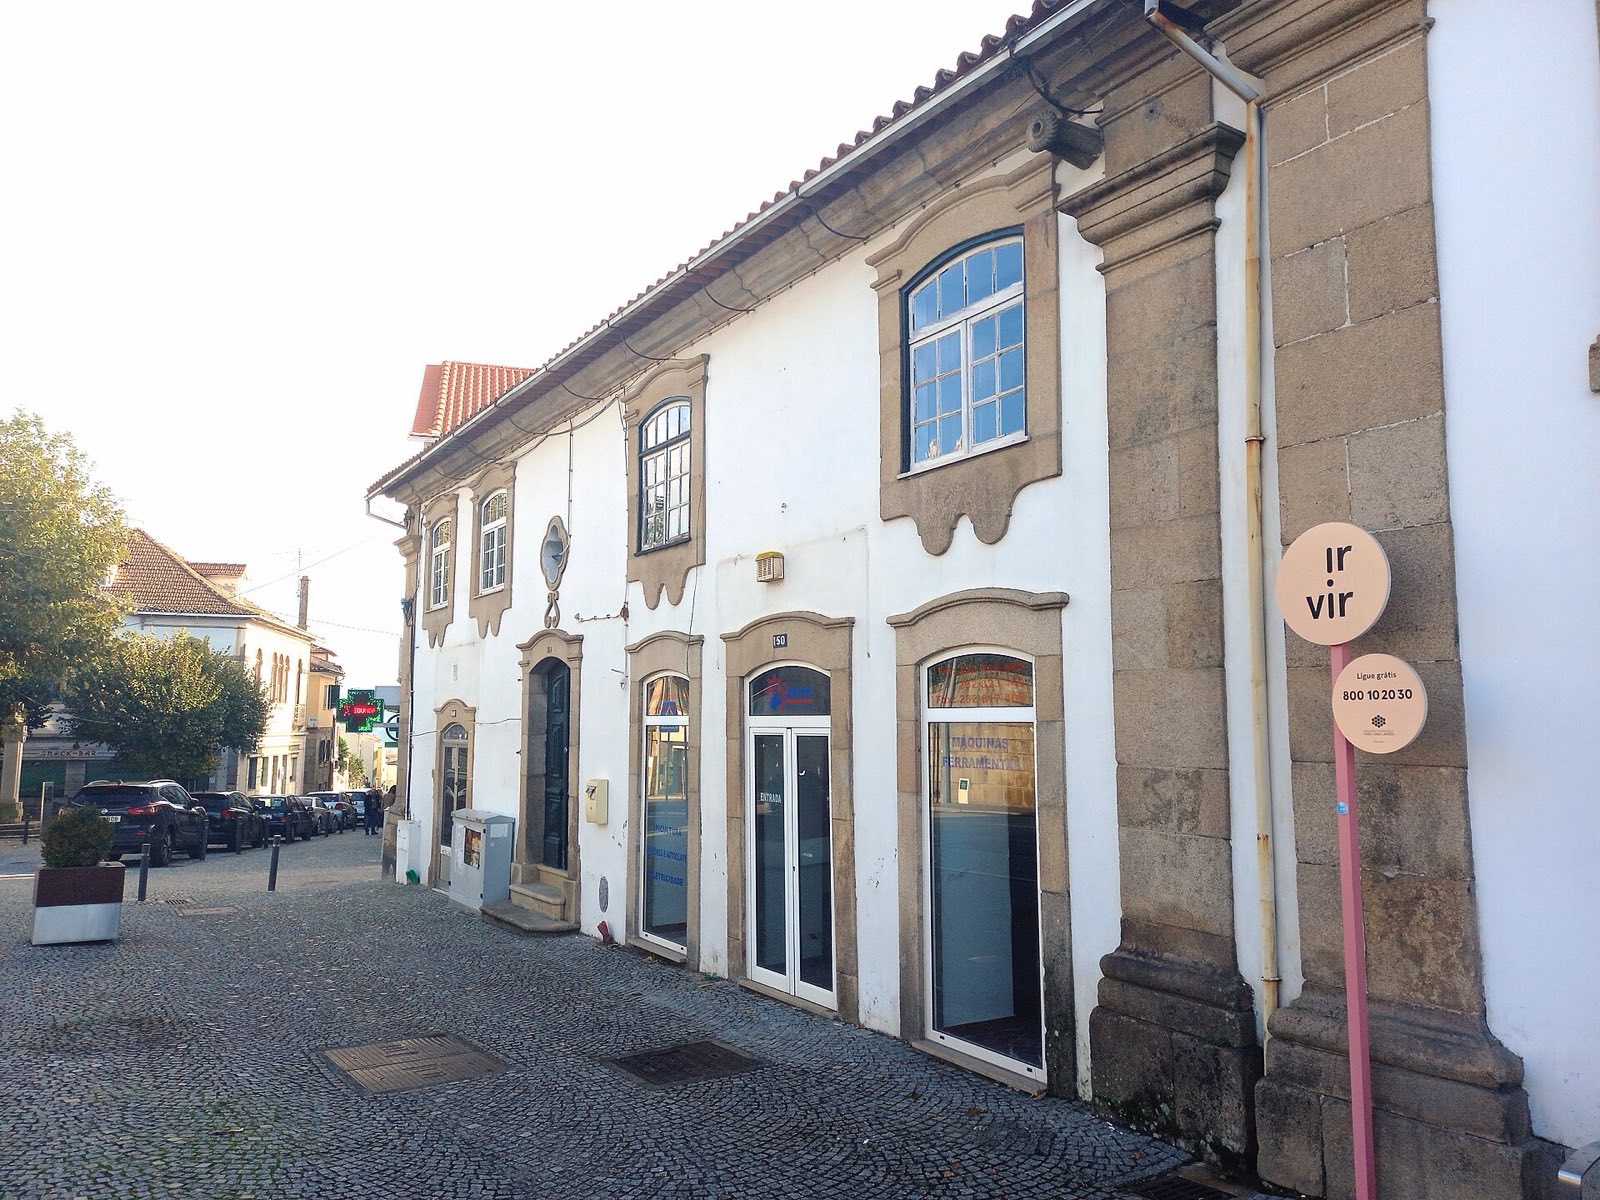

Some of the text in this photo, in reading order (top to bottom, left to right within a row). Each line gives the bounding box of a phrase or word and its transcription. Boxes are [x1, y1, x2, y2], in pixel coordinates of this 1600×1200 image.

[1356, 672, 1397, 681] Ligue grátis
[1343, 690, 1364, 701] 800
[952, 735, 1008, 749] MÁQUINAS
[761, 792, 781, 803] ENTRADA
